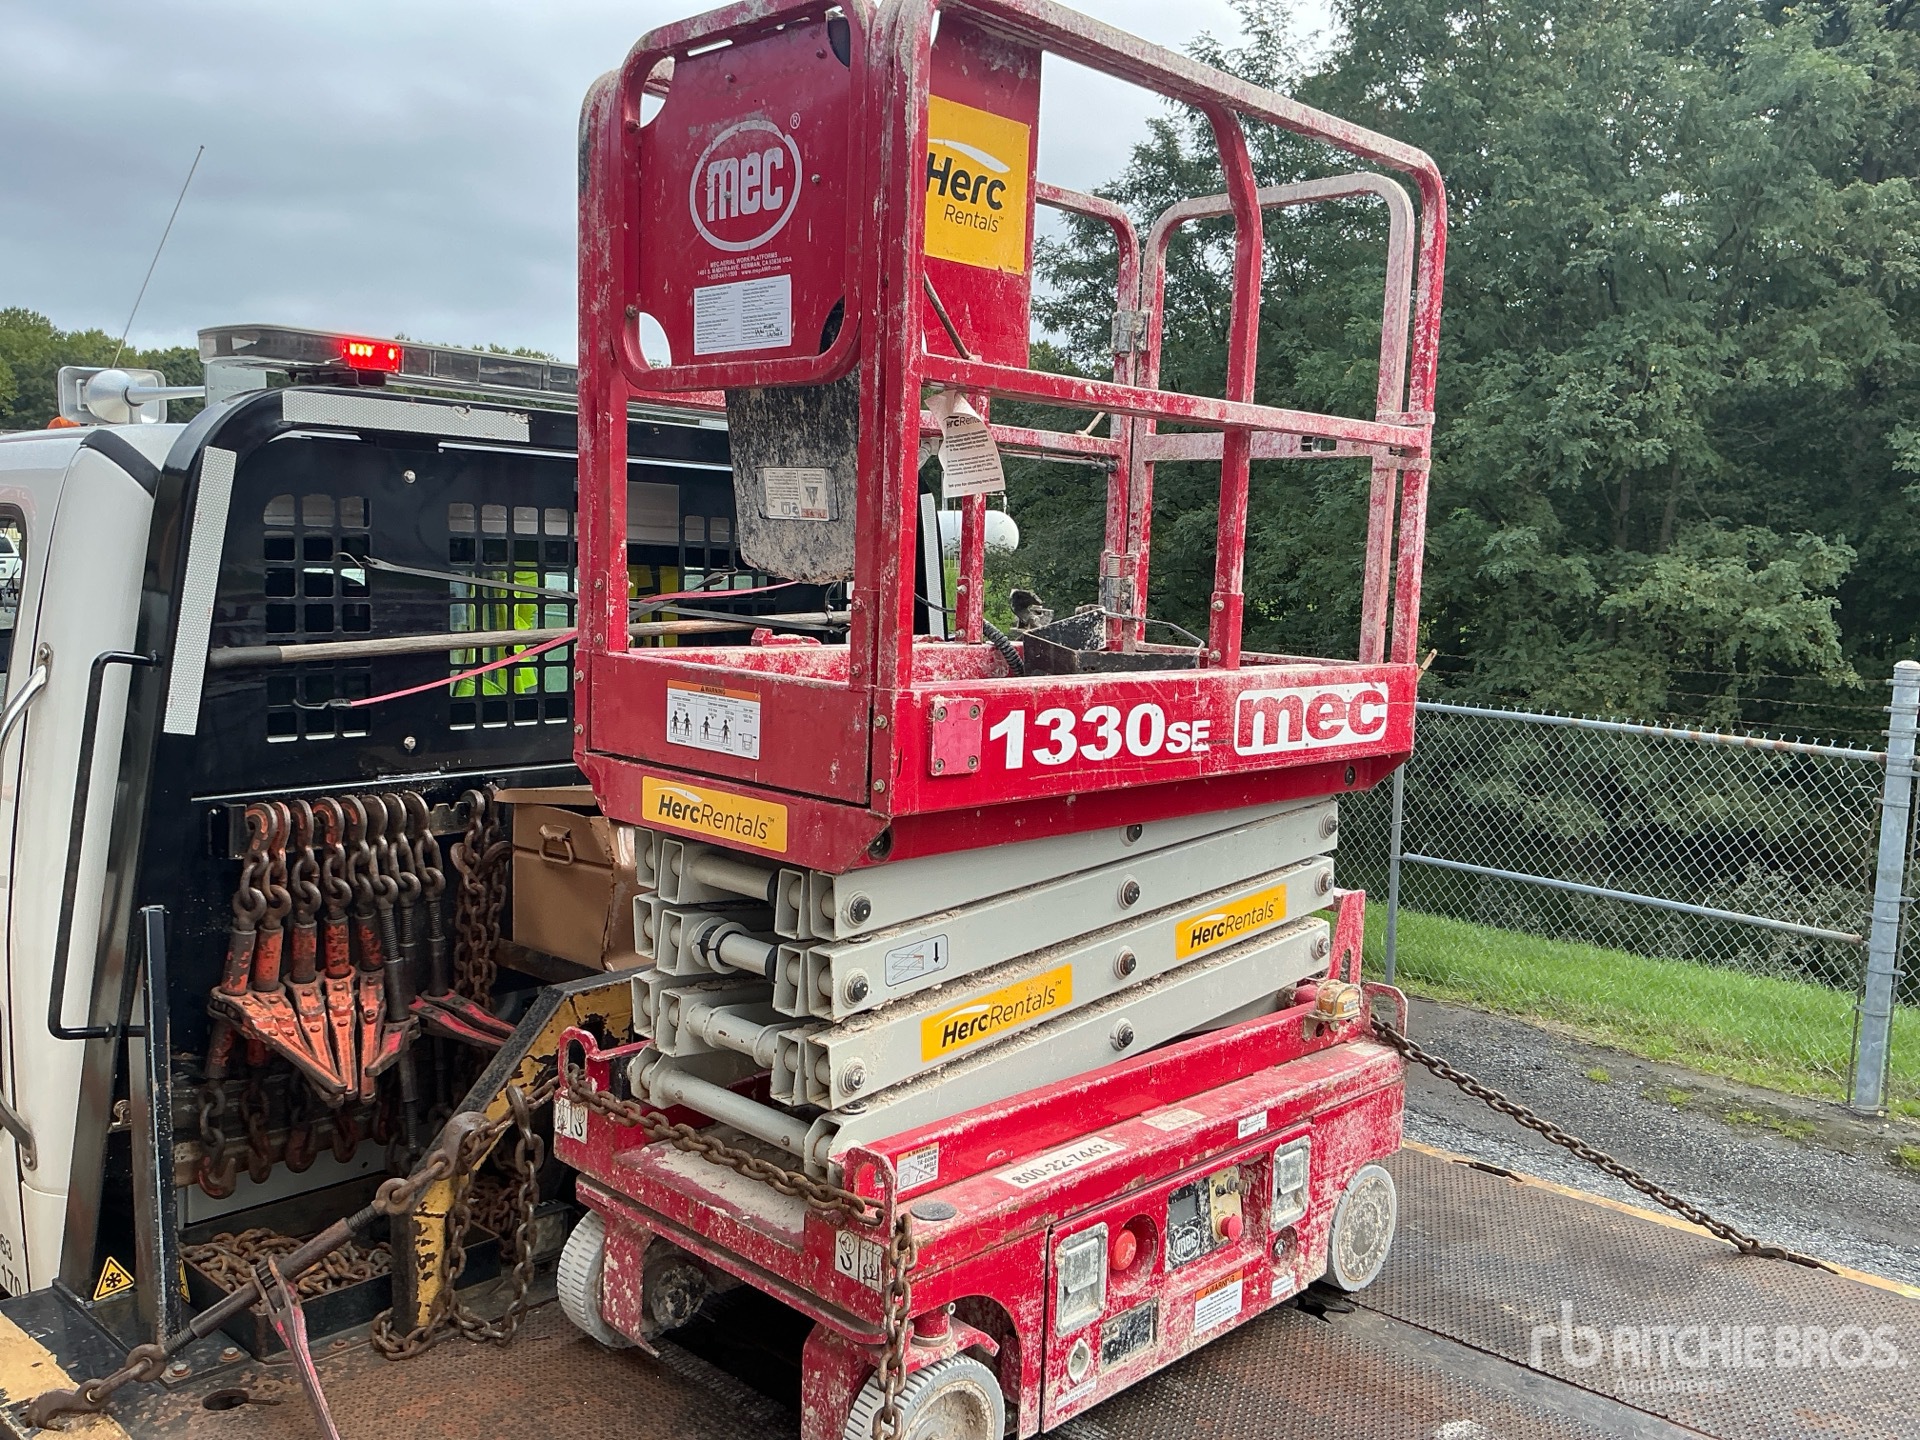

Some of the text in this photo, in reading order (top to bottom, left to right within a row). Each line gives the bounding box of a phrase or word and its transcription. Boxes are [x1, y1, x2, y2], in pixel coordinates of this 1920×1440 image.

[926, 152, 1006, 211] Herc
[944, 194, 999, 233] Rentals
[736, 256, 750, 264] WORK
[750, 251, 778, 262] PLATFORMS
